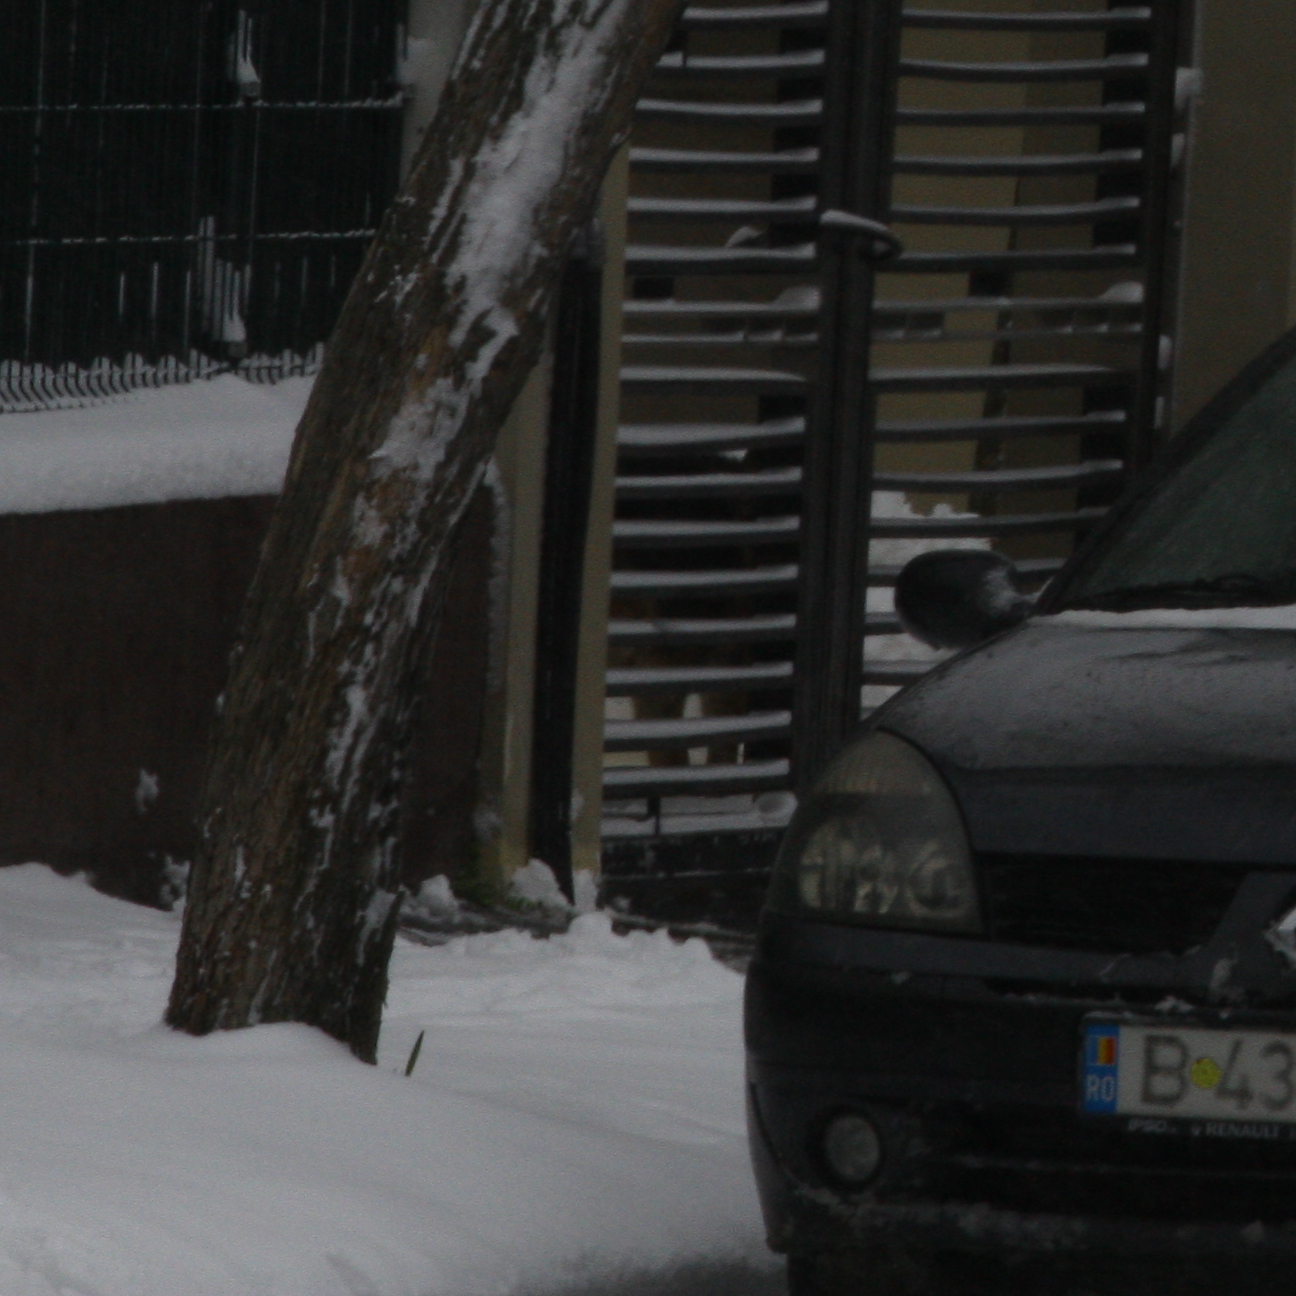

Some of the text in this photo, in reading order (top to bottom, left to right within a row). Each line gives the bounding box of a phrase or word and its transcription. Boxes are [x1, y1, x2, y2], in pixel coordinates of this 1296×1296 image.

[1141, 1034, 1190, 1106] B
[1215, 1038, 1296, 1112] 43
[1087, 1074, 1116, 1102] RO
[1206, 1122, 1280, 1137] RENAULT
